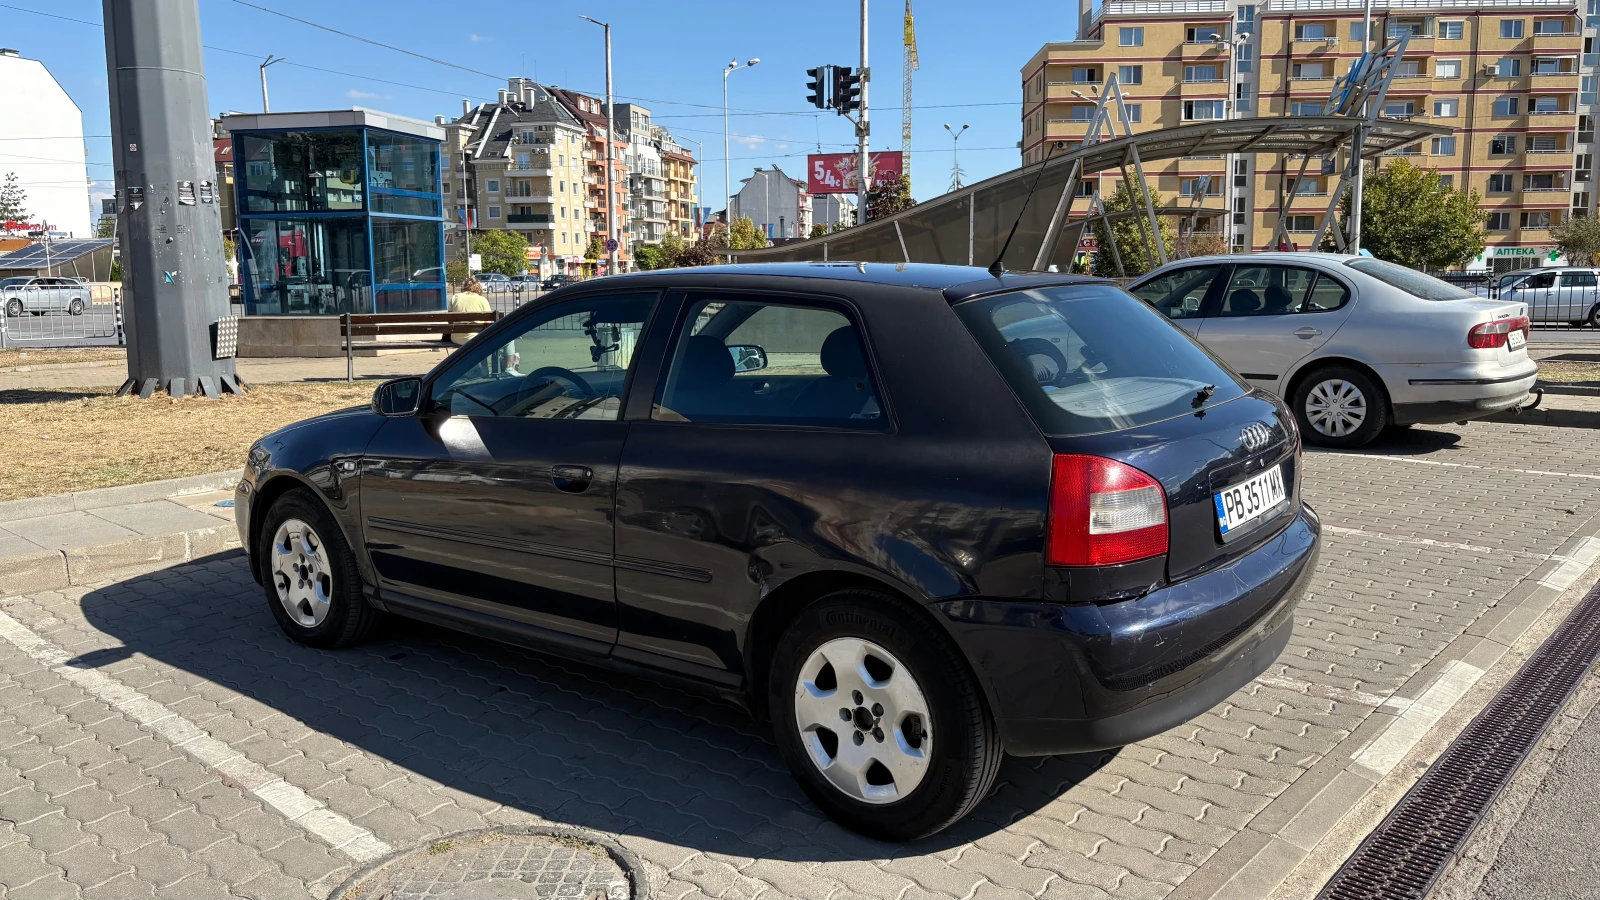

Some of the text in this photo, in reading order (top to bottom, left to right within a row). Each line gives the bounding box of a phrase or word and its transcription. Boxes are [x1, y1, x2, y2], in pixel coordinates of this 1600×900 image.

[814, 160, 825, 180] 5
[1496, 247, 1535, 256] АПТЕКА
[1224, 488, 1244, 524] PB
[1245, 475, 1271, 514] 3511
